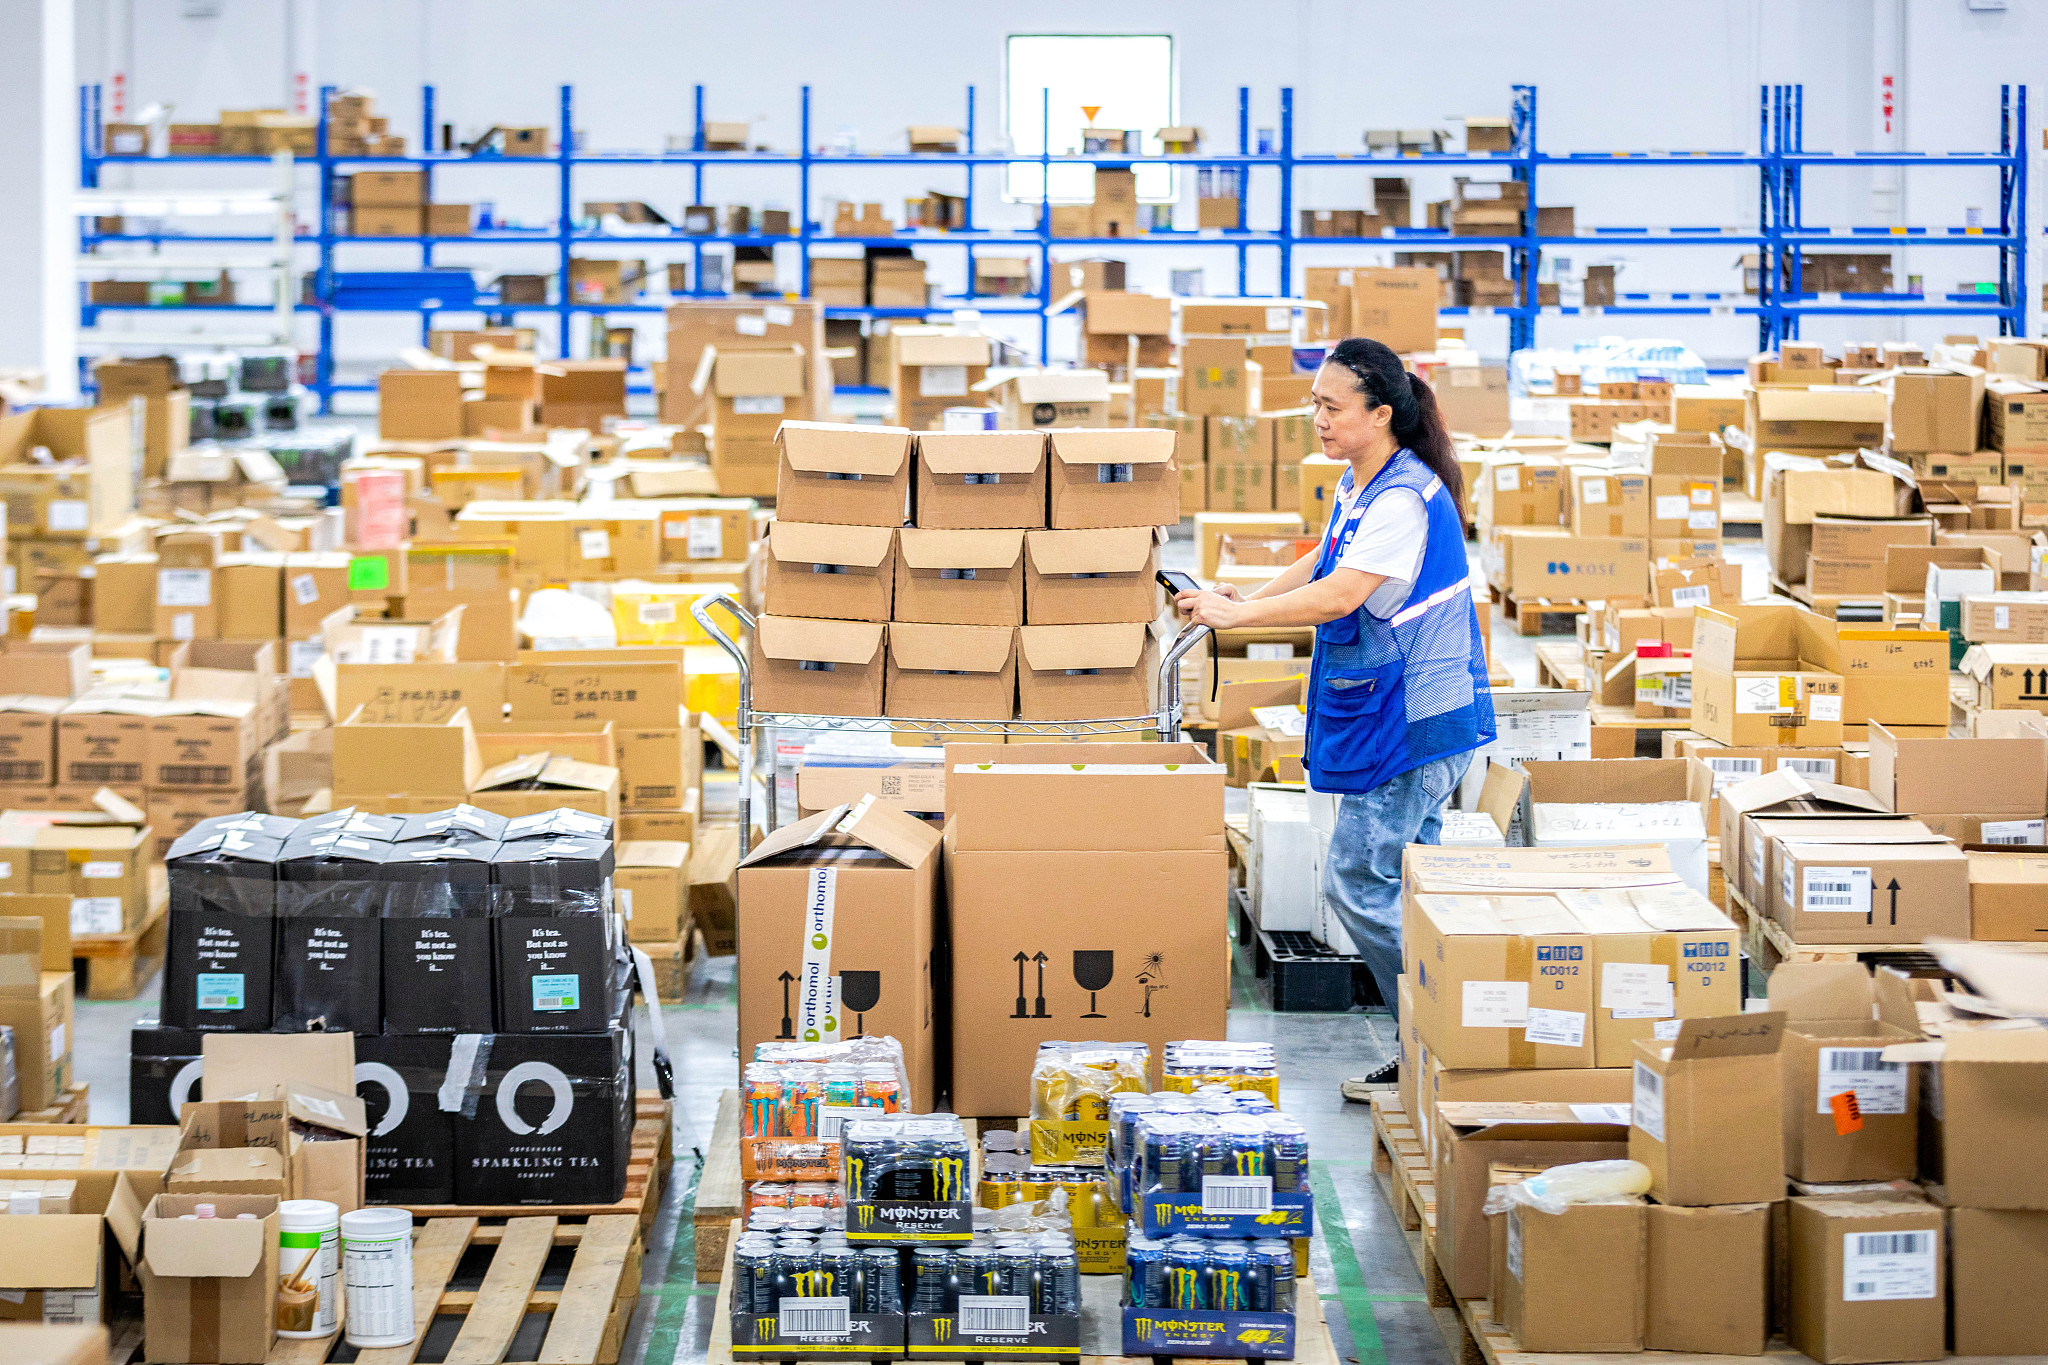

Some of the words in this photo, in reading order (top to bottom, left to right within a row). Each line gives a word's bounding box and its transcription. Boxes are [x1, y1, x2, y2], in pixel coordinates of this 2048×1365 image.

[812, 867, 828, 932] orthomol
[421, 930, 433, 938] It's
[532, 928, 545, 937] It's
[415, 940, 430, 949] But
[432, 941, 446, 949] not
[526, 940, 541, 949] But
[543, 940, 557, 948] not
[416, 953, 432, 962] you
[433, 952, 456, 960] know
[527, 952, 542, 962] you
[544, 950, 567, 959] know
[1540, 966, 1579, 976] KD012
[1687, 962, 1726, 972] KD012
[1555, 981, 1564, 990] D
[1702, 977, 1711, 986] D
[805, 962, 820, 1026] orthomol
[403, 1158, 434, 1168] TEA
[472, 1158, 563, 1168] SPARKLING
[568, 1157, 600, 1167] TEA
[776, 1158, 830, 1168] MONSTER
[880, 1206, 960, 1220] MONSTER
[1254, 1211, 1288, 1225] 44
[1155, 1319, 1226, 1333] MONSTER
[975, 1335, 1029, 1344] RESERVE
[1236, 1329, 1270, 1344] 44
